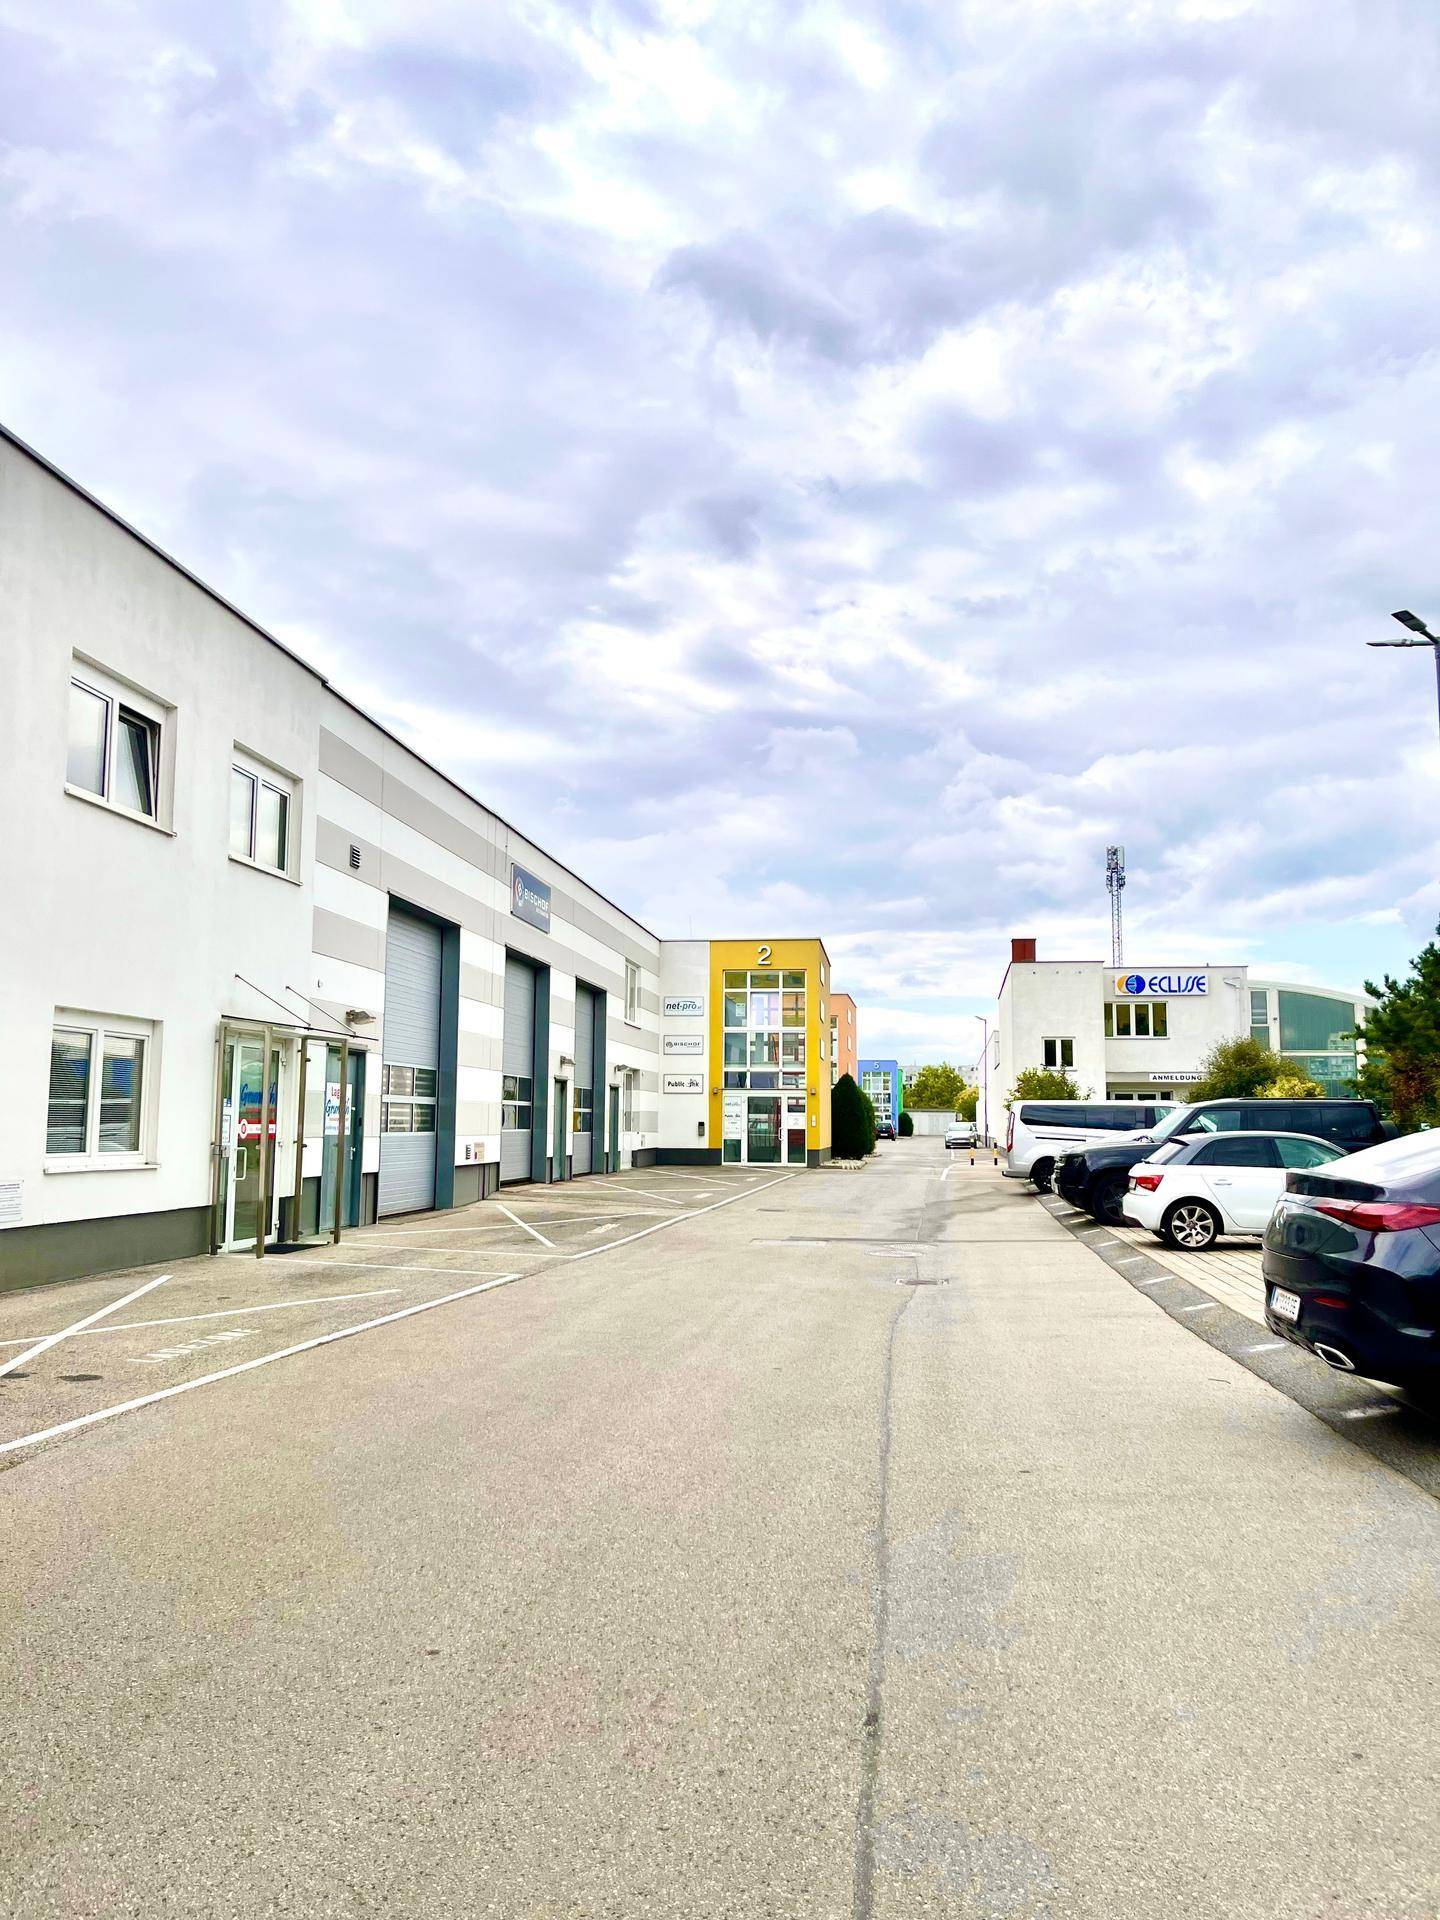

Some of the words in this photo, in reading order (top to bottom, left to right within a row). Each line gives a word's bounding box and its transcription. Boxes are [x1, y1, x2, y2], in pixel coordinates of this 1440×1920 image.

[757, 944, 772, 965] 2
[1148, 975, 1206, 993] ECLISSE
[667, 1080, 685, 1088] Public
